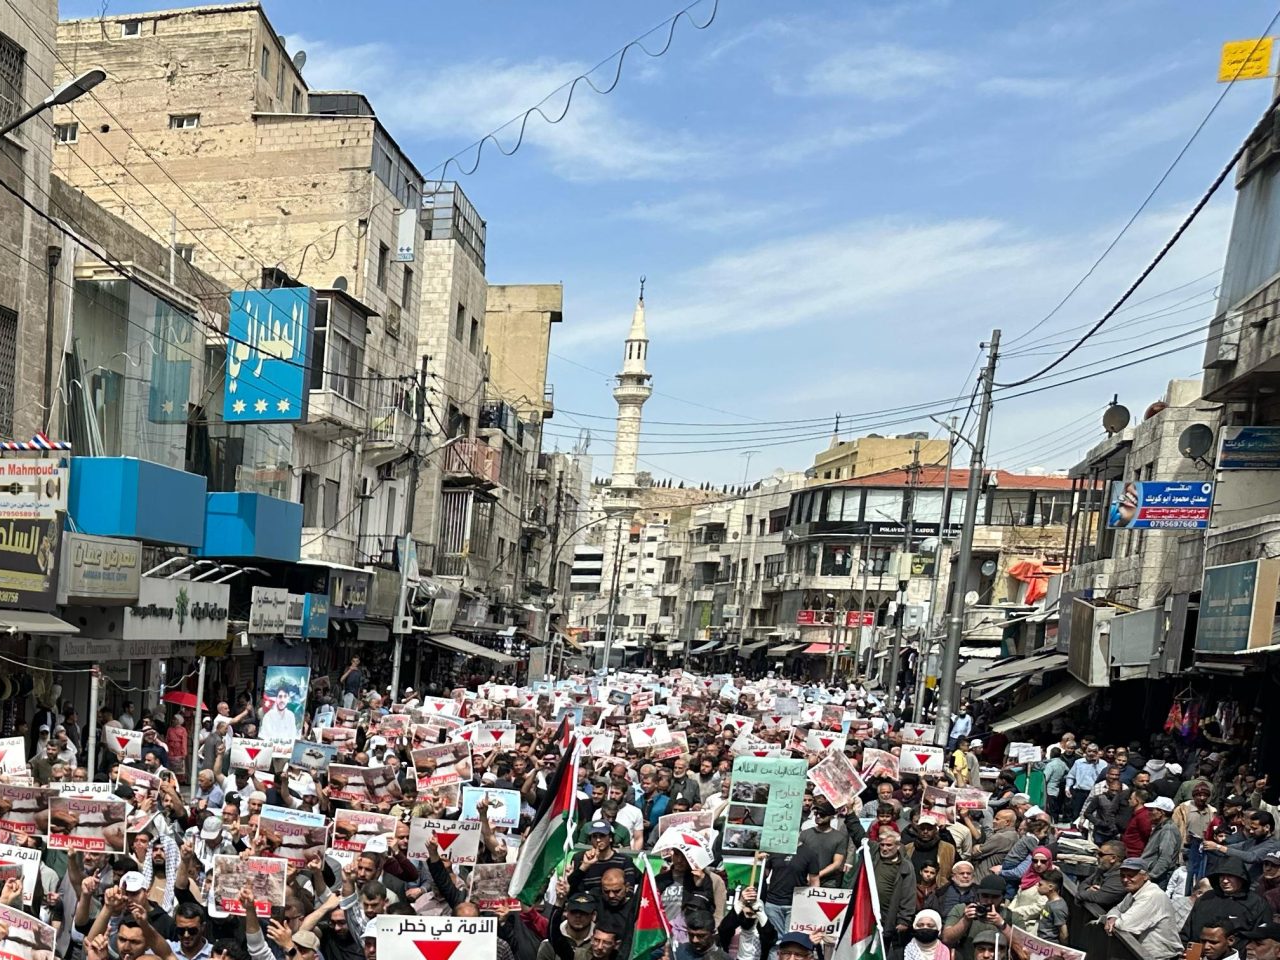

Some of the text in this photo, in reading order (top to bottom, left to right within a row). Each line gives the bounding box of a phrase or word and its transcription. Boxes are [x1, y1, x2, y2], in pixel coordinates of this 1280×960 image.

[8, 463, 53, 475] Mahmoud
[807, 888, 826, 899] خطر
[398, 919, 494, 940] الأمة في خطر
[791, 918, 840, 934] أو نكون
[1023, 936, 1054, 957] امريكا
